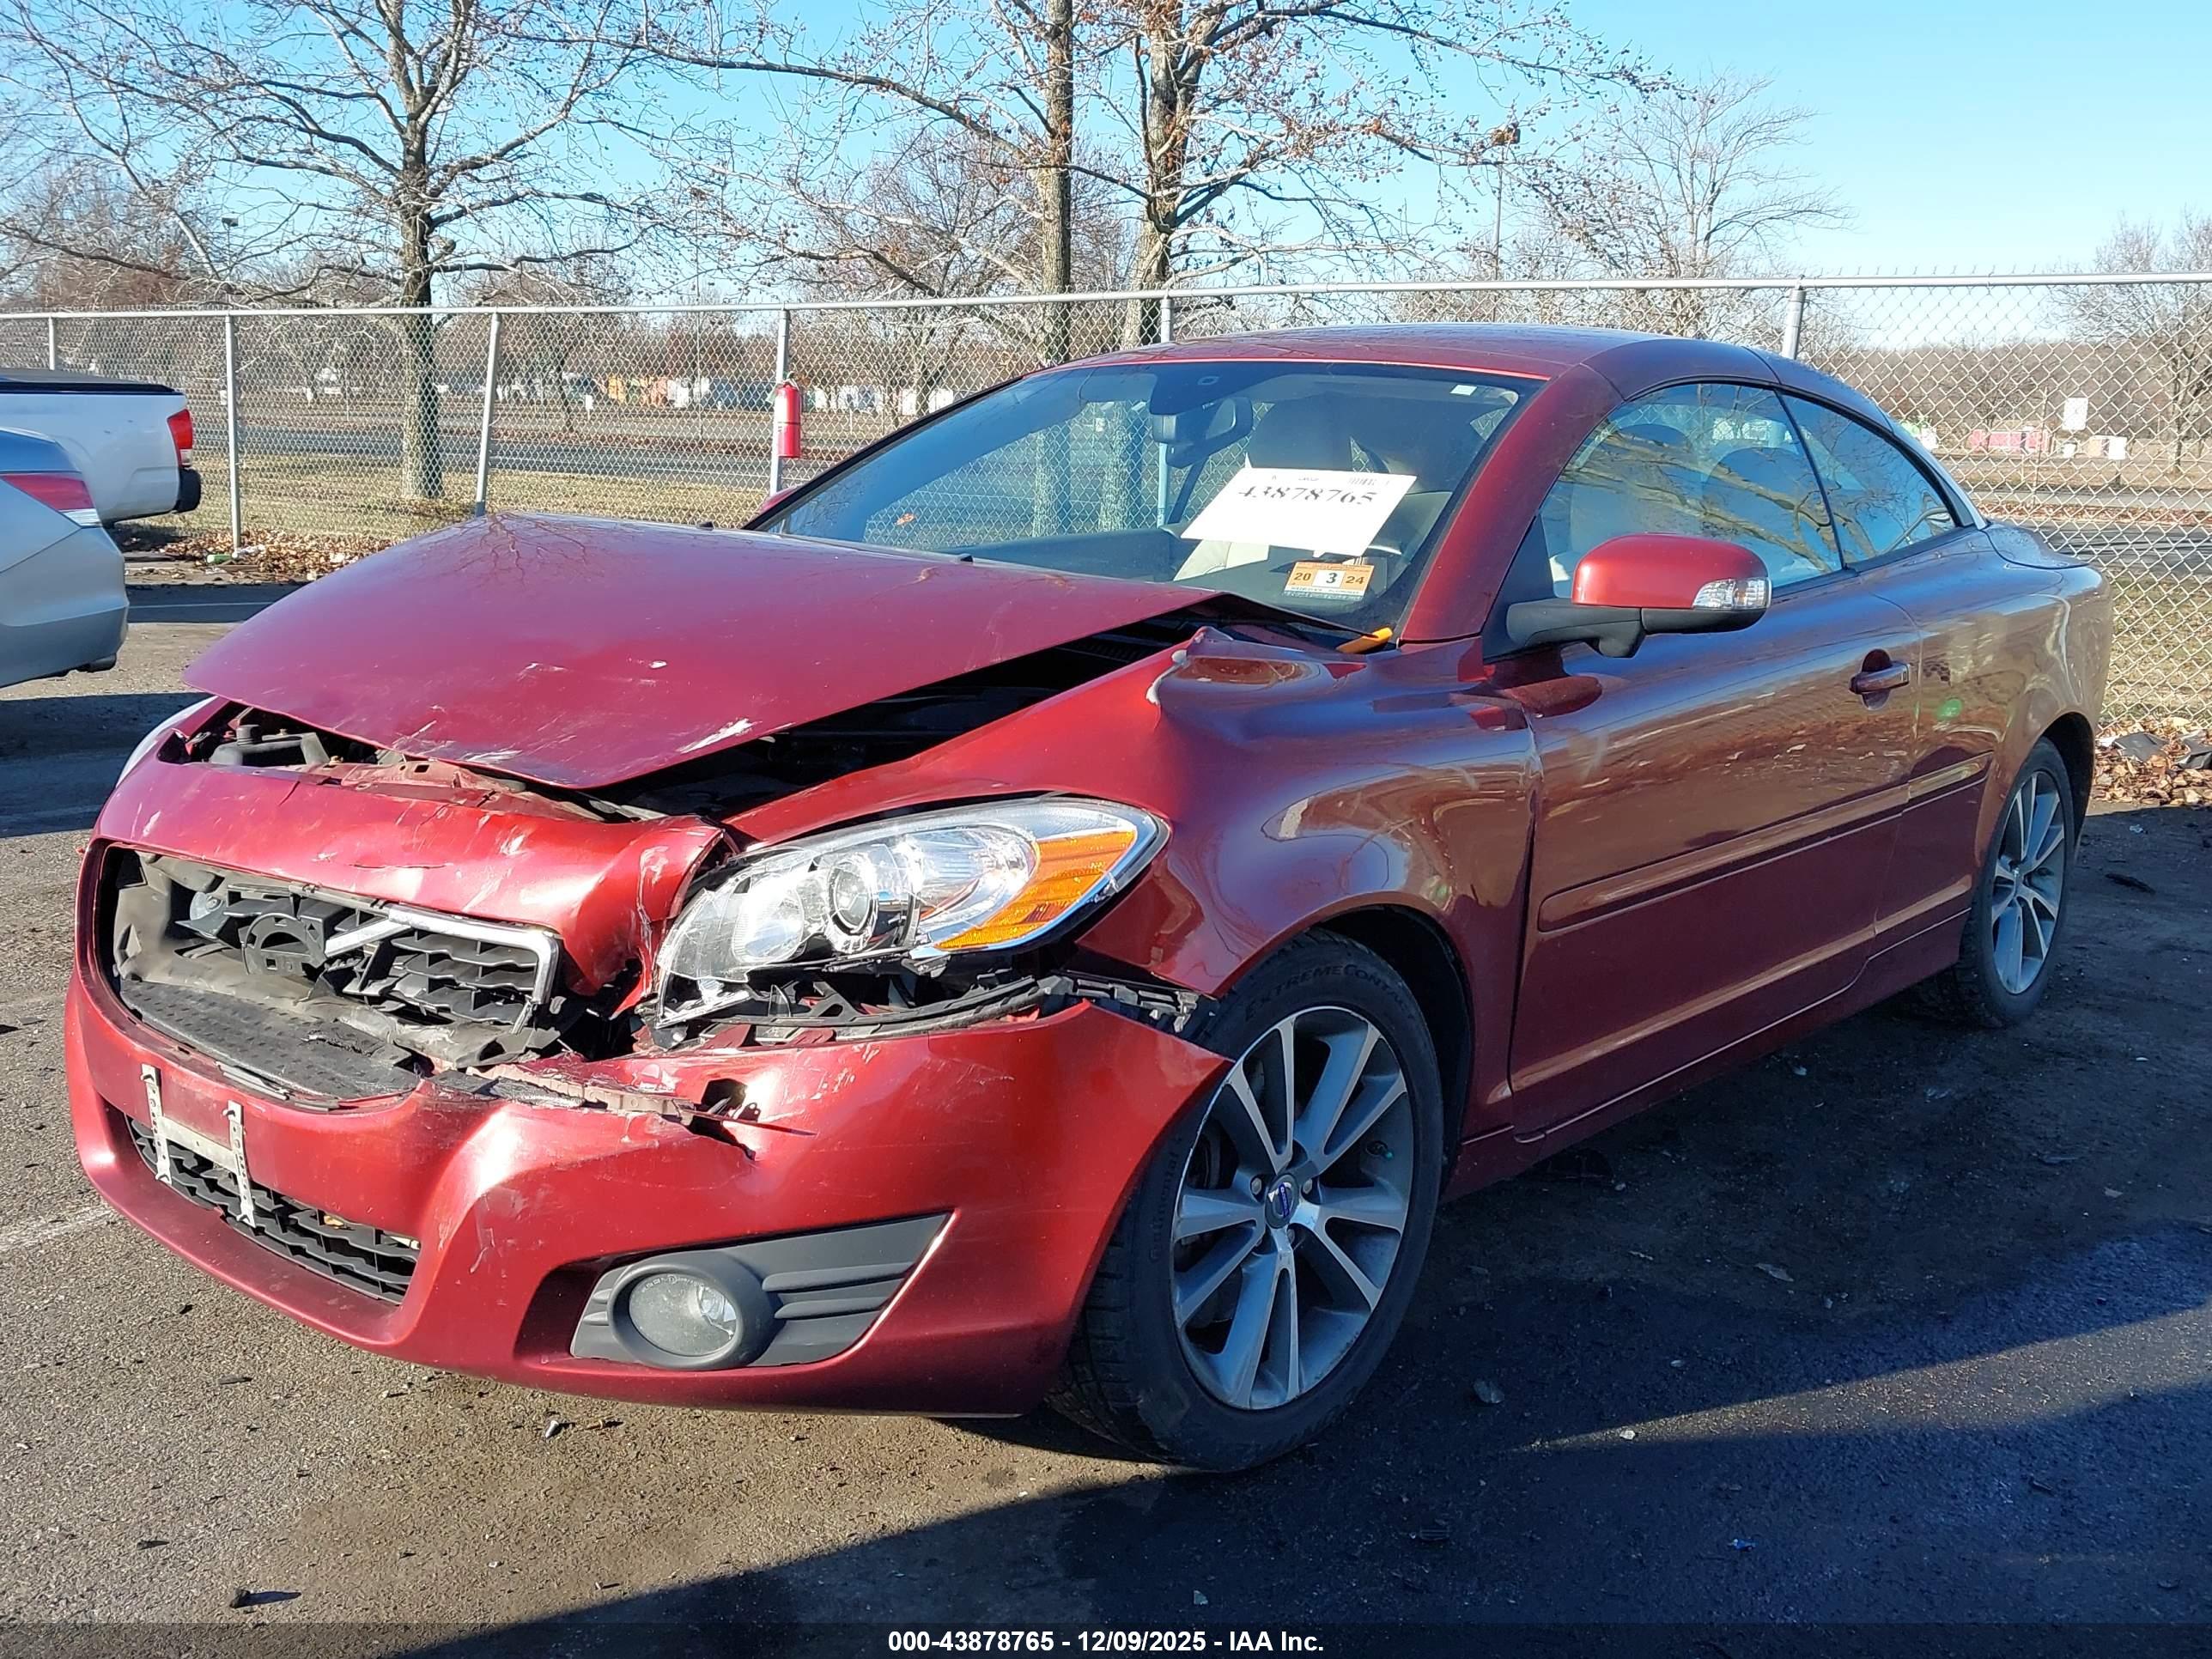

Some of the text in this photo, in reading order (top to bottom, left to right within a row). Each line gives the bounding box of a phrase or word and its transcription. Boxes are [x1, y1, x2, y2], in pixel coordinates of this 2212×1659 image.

[1238, 485, 1377, 505] 43878765
[1293, 571, 1364, 586] 20 3 24
